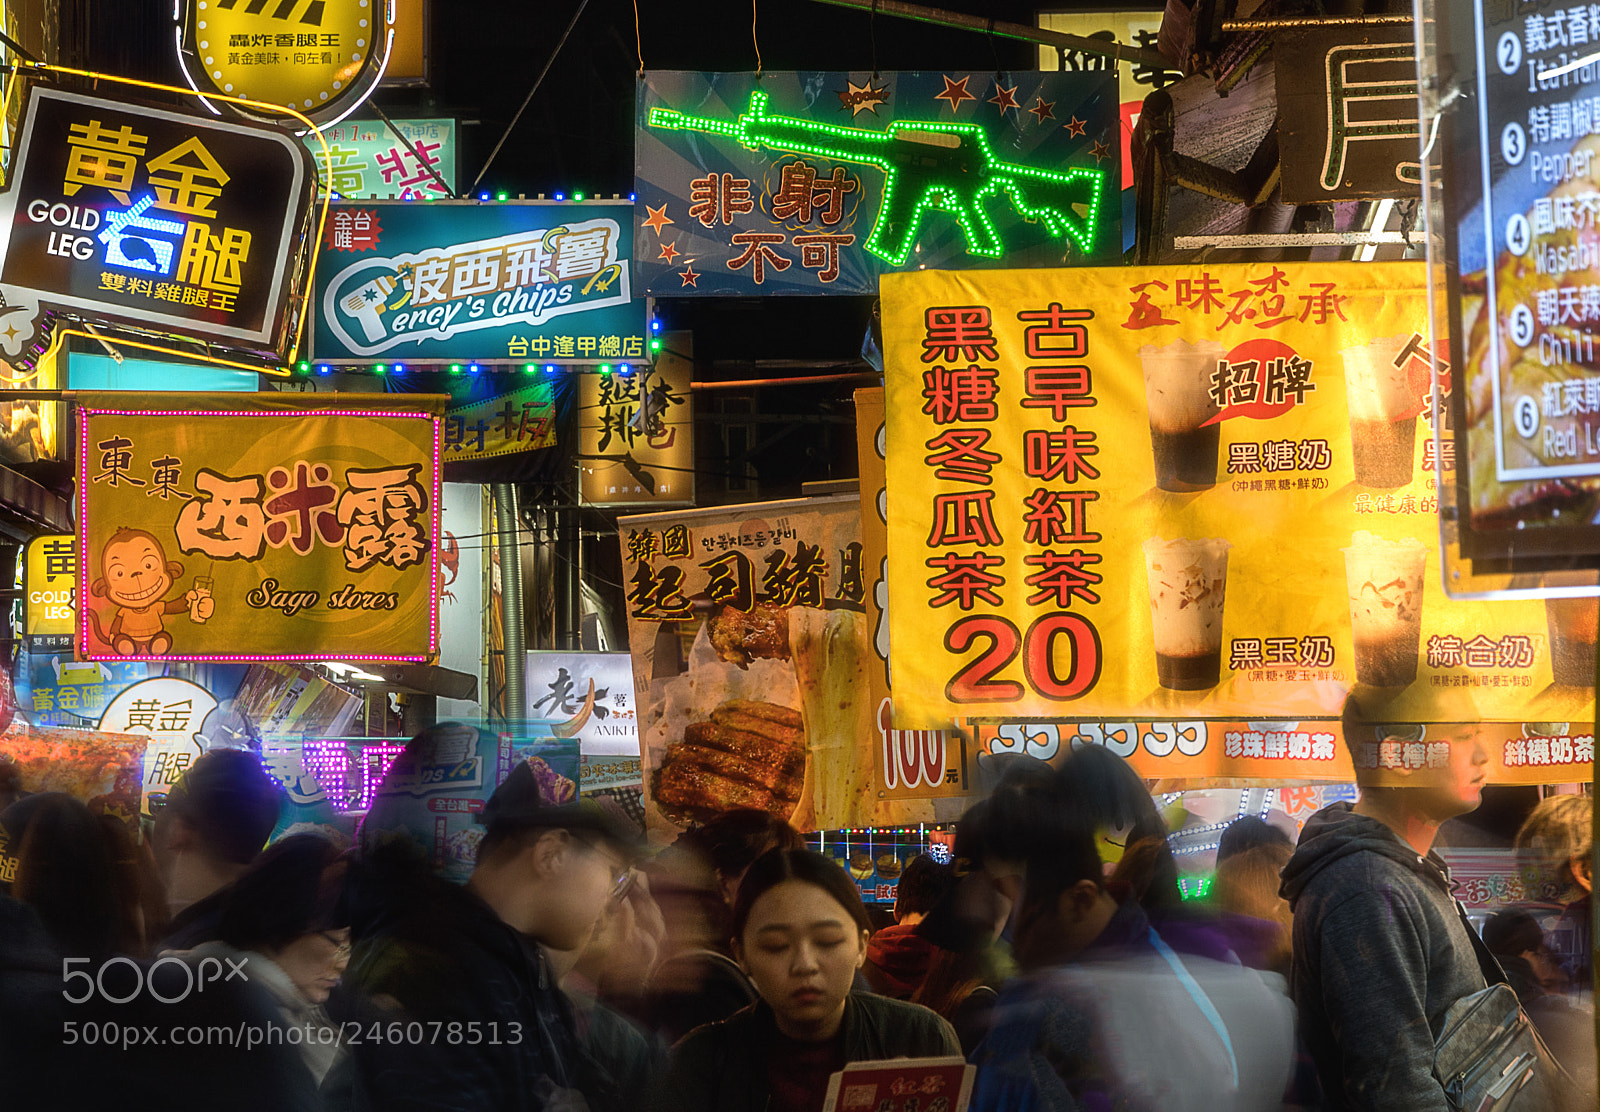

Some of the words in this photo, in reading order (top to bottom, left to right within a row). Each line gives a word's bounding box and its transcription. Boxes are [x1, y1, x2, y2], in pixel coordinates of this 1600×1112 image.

[228, 33, 341, 47] 轟炸香腿王
[1527, 50, 1600, 93] Italia
[1530, 149, 1595, 184] Pepper
[689, 160, 855, 228] 非射
[27, 200, 100, 231] GOLD
[1533, 191, 1600, 235] 風味芥
[47, 232, 94, 261] LEG
[727, 232, 855, 284] 不可
[1535, 234, 1599, 275] Wasabi
[98, 271, 236, 313] 雙料雞腿王
[492, 283, 572, 317] Chips
[507, 335, 644, 358] 台中逢甲總店
[1539, 327, 1593, 367] Chili
[1208, 355, 1317, 406] 招牌
[921, 304, 1005, 610] 黑糖冬瓜茶
[1018, 302, 1102, 608] 古早味紅茶
[1227, 439, 1332, 474] 黑糖奶
[1543, 423, 1577, 458] Red
[93, 434, 194, 501] 東東
[175, 460, 431, 573] 西米露
[626, 524, 694, 562] 韓國
[30, 591, 70, 604] GOLD
[45, 606, 70, 619] LEG
[247, 577, 318, 617] Sago
[328, 583, 399, 611] stores
[944, 611, 1103, 703] 20
[1229, 636, 1335, 670] 黑玉奶
[1427, 634, 1534, 668] 綜合奶
[124, 698, 192, 732] 黃金
[594, 725, 627, 736] ANIKI
[1225, 732, 1336, 760] 珍珠鮮奶茶
